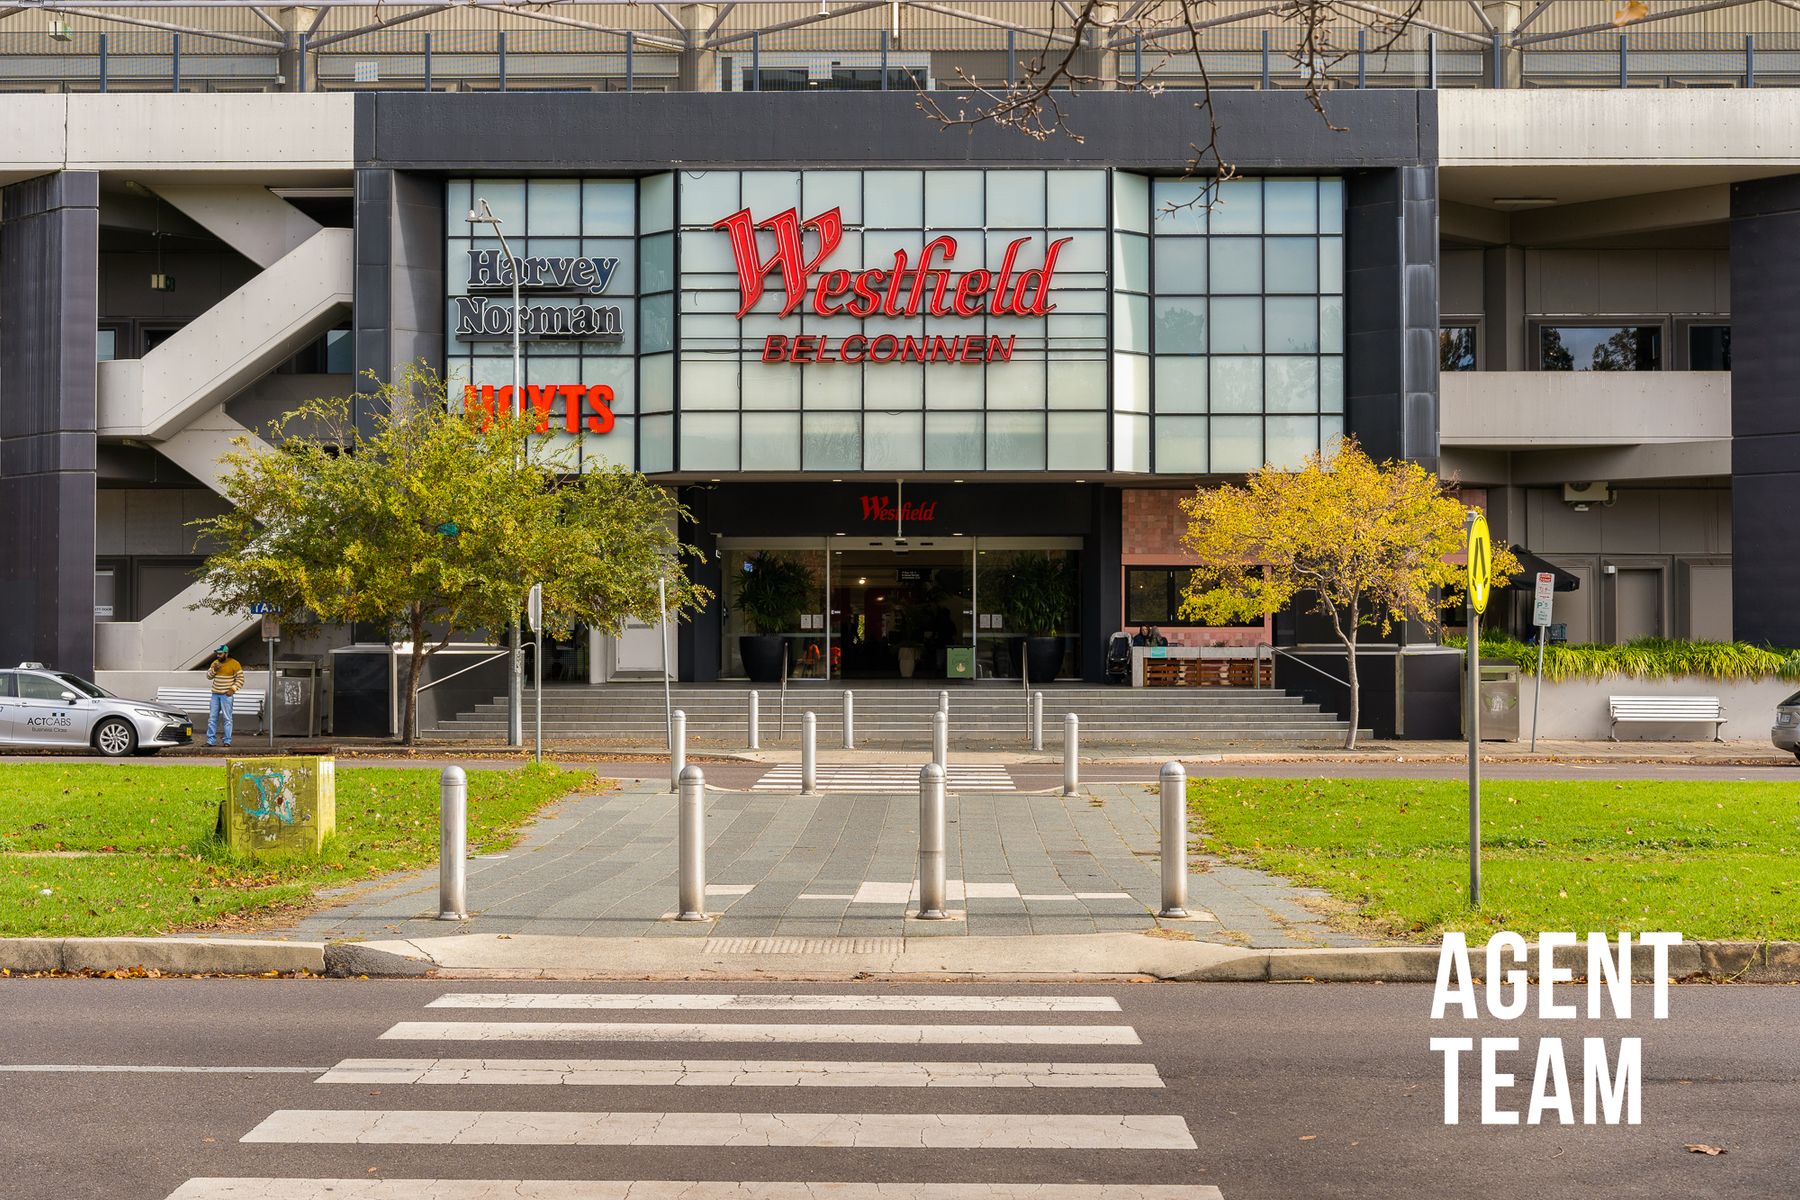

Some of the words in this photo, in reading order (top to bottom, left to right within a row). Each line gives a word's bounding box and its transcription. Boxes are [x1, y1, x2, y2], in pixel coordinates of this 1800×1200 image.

[466, 249, 619, 294] Harvey
[712, 206, 1073, 319] Westfield
[455, 297, 624, 334] Norman
[761, 333, 1016, 364] BELCONNEN
[27, 717, 72, 726] ACTCABS
